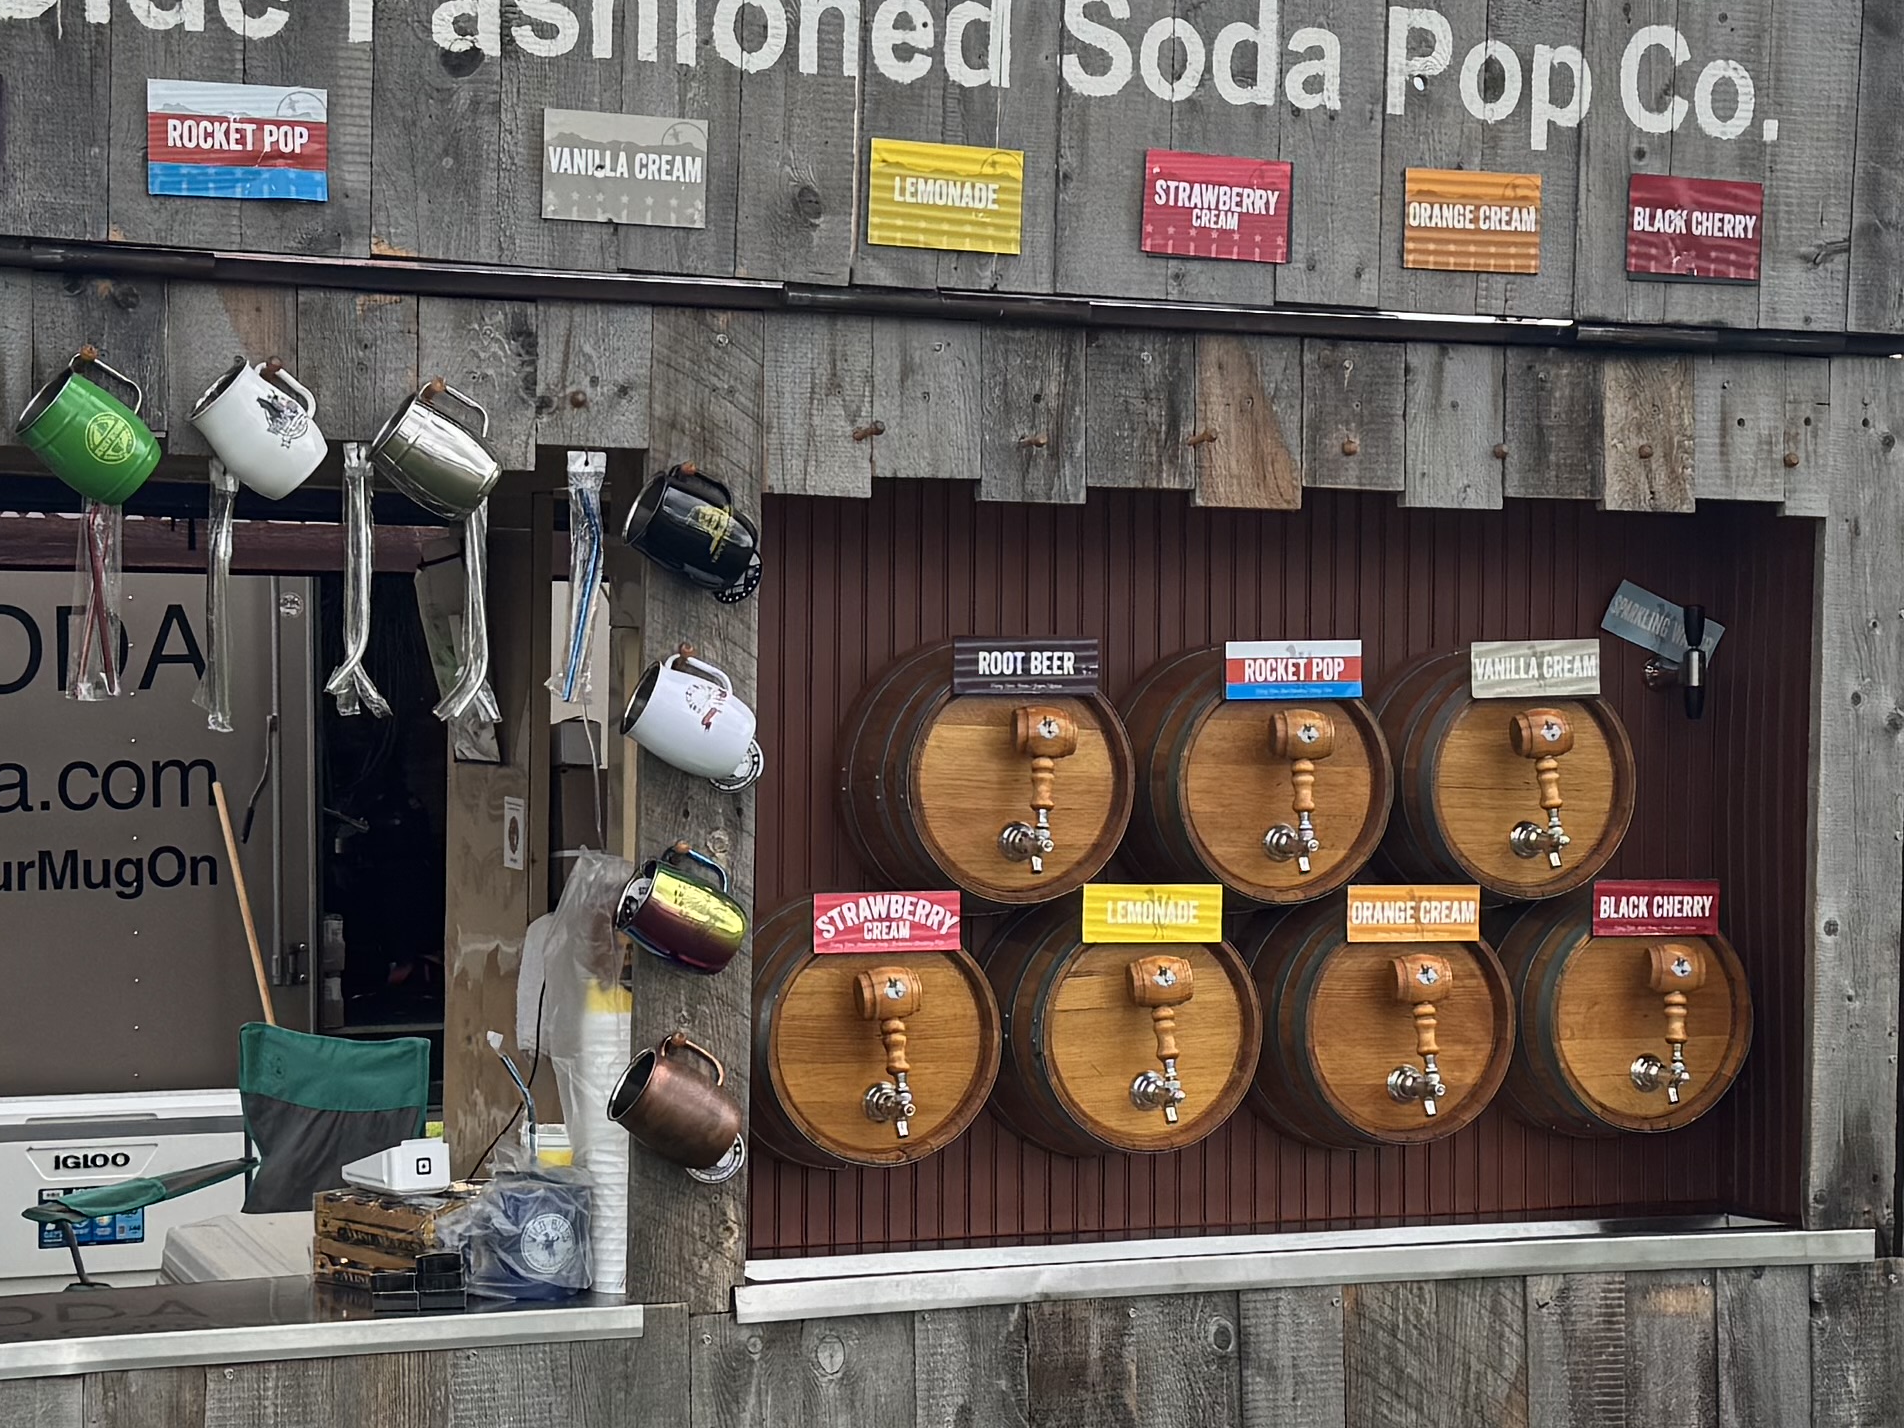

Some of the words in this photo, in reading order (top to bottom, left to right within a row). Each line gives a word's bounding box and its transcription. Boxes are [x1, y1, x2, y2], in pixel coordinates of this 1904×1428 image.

[1386, 7, 1592, 150] Pop
[1621, 25, 1778, 141] Co.
[167, 118, 257, 153] ROCKET
[264, 123, 309, 154] POP
[549, 146, 628, 179] VANILLA
[634, 150, 702, 184] CREAM
[893, 178, 1000, 210] LEMONADE
[1154, 179, 1279, 217] STRAWBERRY
[1191, 209, 1238, 230] CREAM
[1408, 201, 1472, 231] ORANGE
[1476, 204, 1536, 234] CREAM
[1633, 208, 1688, 236] BLACK
[1691, 210, 1756, 240] CHERRY
[1614, 594, 1670, 638] SPARKLING
[978, 651, 1026, 675] ROOT
[1030, 652, 1076, 675] BEER
[1245, 658, 1307, 683] ROCKET
[1312, 658, 1345, 680] POP
[1475, 657, 1538, 680] VANILLA
[1543, 655, 1596, 678] CREAM
[815, 894, 960, 939] STRAWBERRY
[1106, 900, 1199, 924] LEMONADE
[1352, 901, 1415, 924] ORANGE
[1420, 901, 1475, 923] CREAM
[1600, 896, 1648, 918] BLACK
[1653, 896, 1713, 917] CHERRY
[864, 920, 910, 940] CREAM
[54, 1153, 130, 1170] IGLOO
